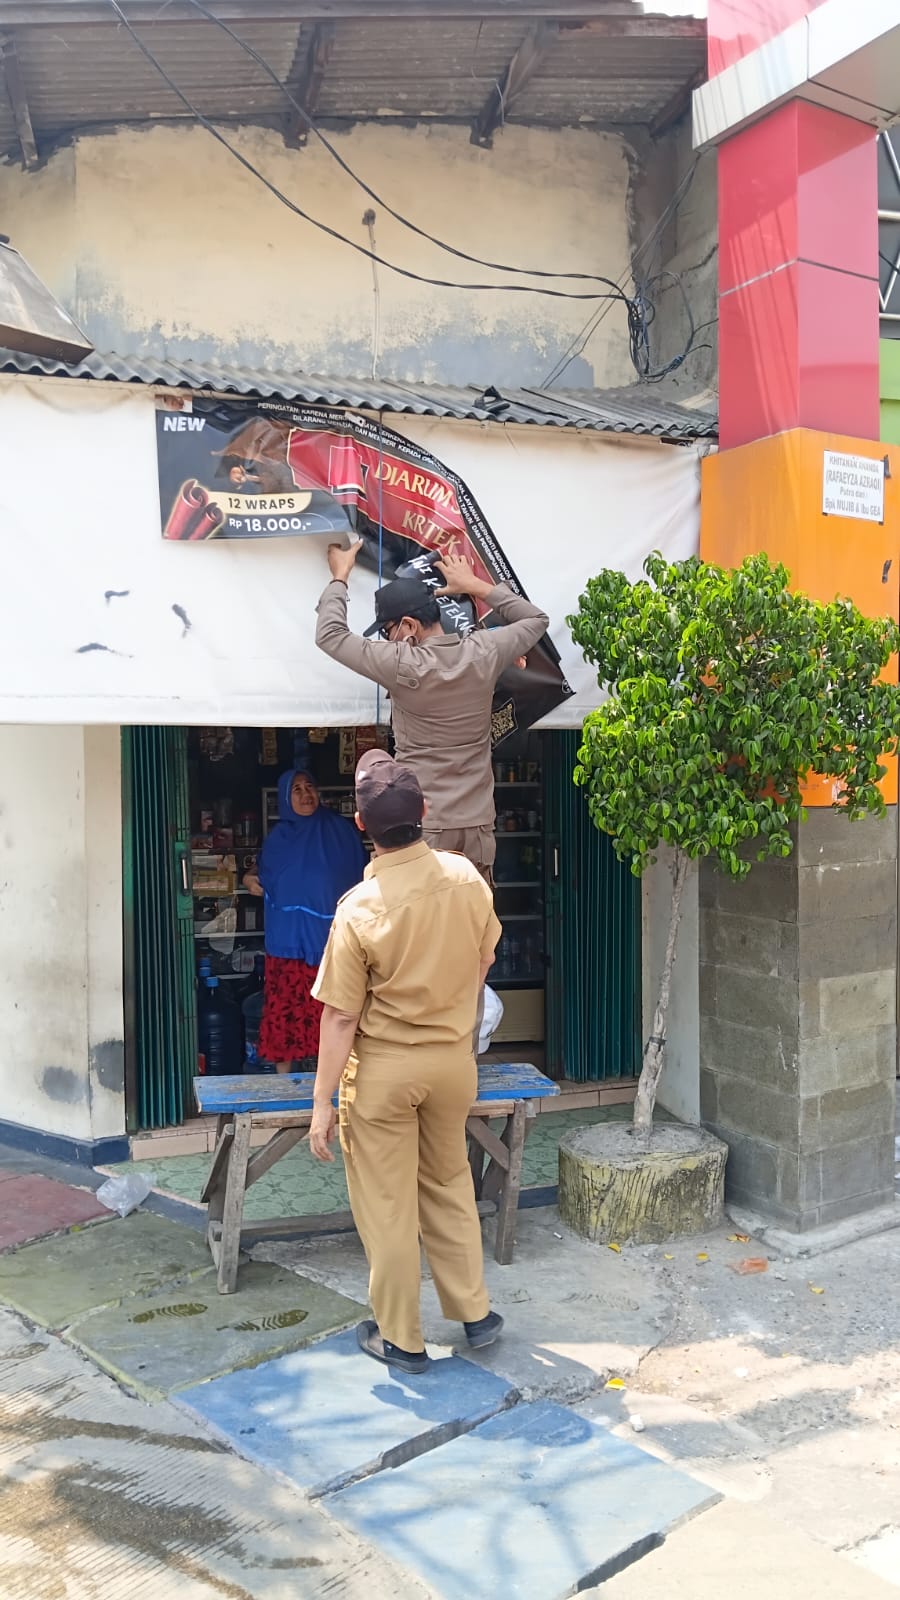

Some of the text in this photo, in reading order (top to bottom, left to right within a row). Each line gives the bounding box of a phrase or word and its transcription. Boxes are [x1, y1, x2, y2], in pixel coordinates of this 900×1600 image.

[163, 416, 206, 432] NEW
[301, 409, 327, 418] KARENA
[292, 414, 326, 424] DILARANG
[355, 426, 367, 436] DAN
[398, 444, 422, 460] KEPADA
[374, 461, 454, 508] DJARUM
[228, 497, 296, 510] 12 WRAPS
[228, 517, 312, 532] Rp 18.000,-
[460, 502, 474, 525] TAHUN
[471, 525, 482, 539] DAN
[479, 537, 502, 574] PEREMPUAN
[463, 494, 481, 522] LAYANAN
[477, 521, 497, 551] BERHENTI
[494, 550, 513, 579] MEROKOK
